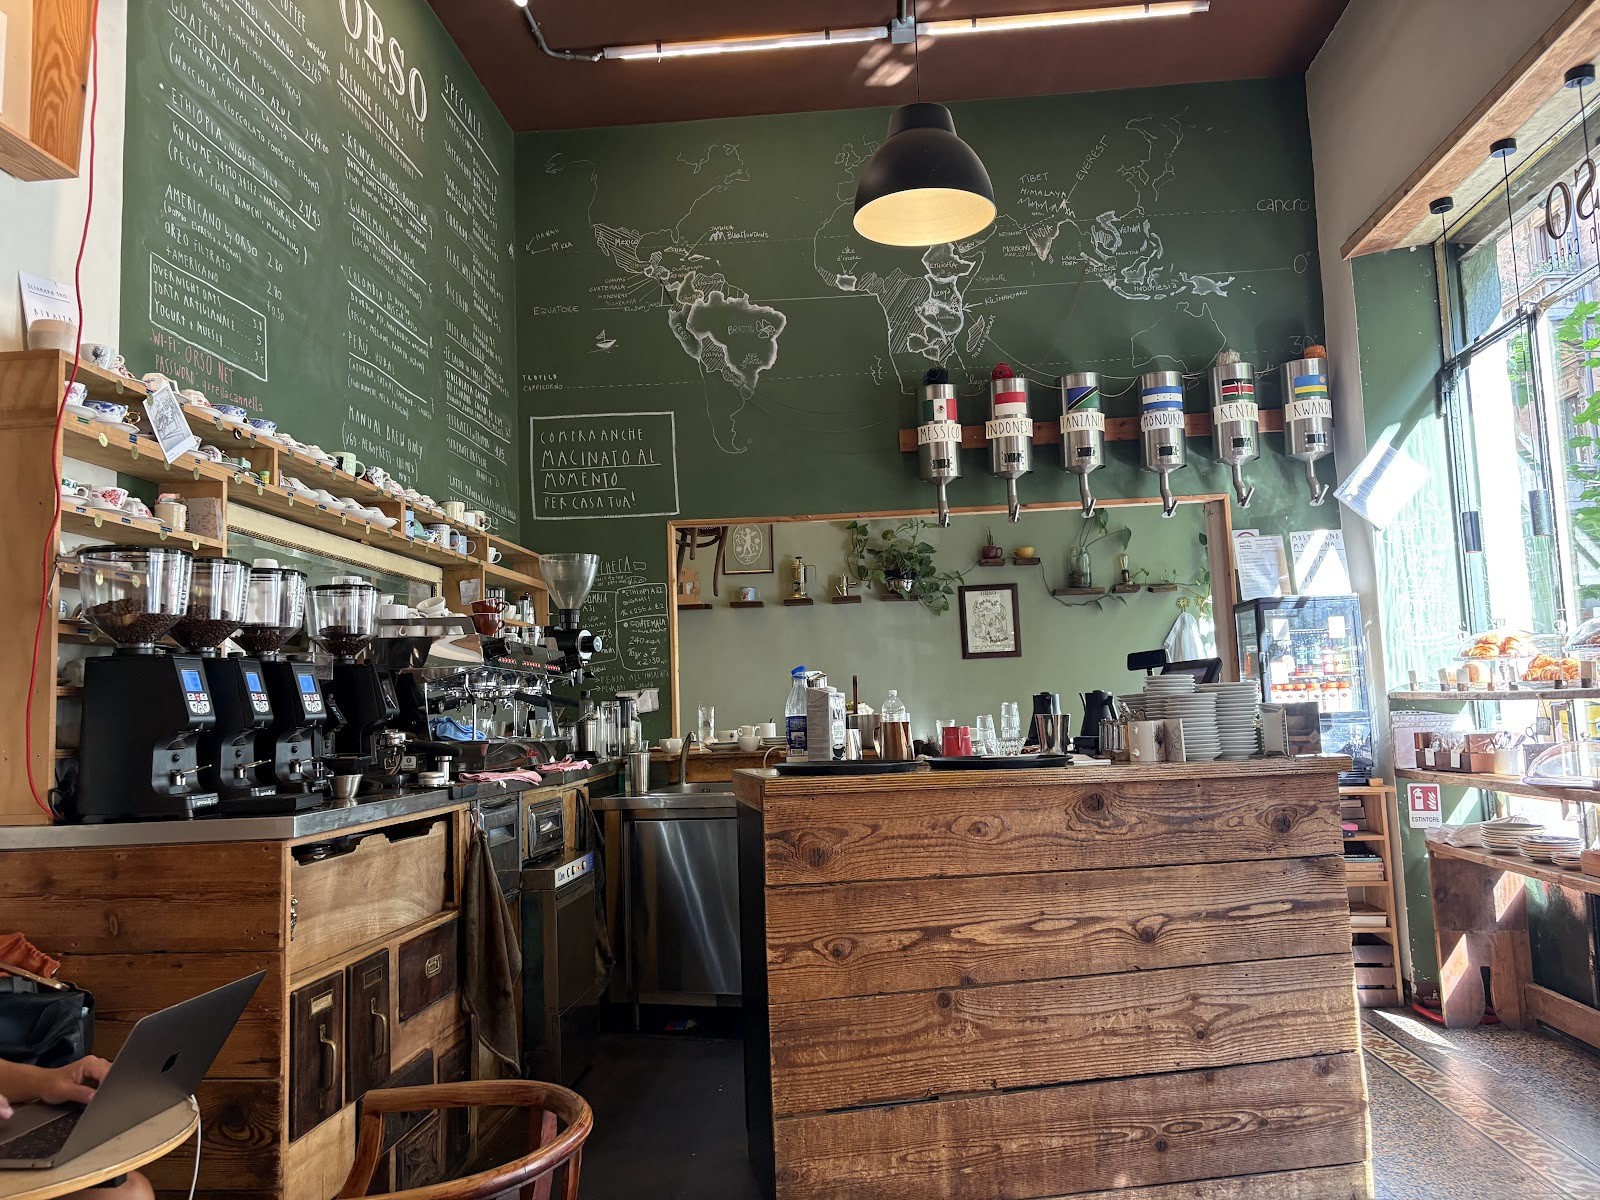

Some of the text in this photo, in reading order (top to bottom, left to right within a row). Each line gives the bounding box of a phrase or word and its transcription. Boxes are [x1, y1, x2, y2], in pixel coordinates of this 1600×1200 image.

[338, 0, 428, 122] ORSO
[250, 74, 264, 96] RIO
[270, 96, 292, 126] AZUL
[1076, 135, 1108, 181] EVEREST
[1256, 198, 1310, 213] cancro
[164, 184, 222, 232] AMERICANO
[234, 232, 258, 258] ORSO
[164, 222, 188, 246] ORZO
[194, 238, 232, 272] FILTRATO
[152, 262, 200, 294] OVERNIGHT
[154, 280, 180, 300] TORTA
[154, 298, 186, 326] YOGURT
[534, 305, 580, 315] EQUATORE
[184, 346, 212, 376] ORSO
[218, 362, 234, 384] NET
[523, 383, 564, 392] CAPRICORNO
[1220, 402, 1256, 420] KENYA
[348, 406, 382, 436] MANUAL
[386, 424, 406, 446] BREW
[540, 428, 644, 444] COMPRA ANCHE
[920, 425, 960, 442] MESSICO
[542, 448, 656, 468] MACINATO AL
[544, 472, 618, 488] MOMENTO
[544, 490, 637, 510] PER CASA TUA!
